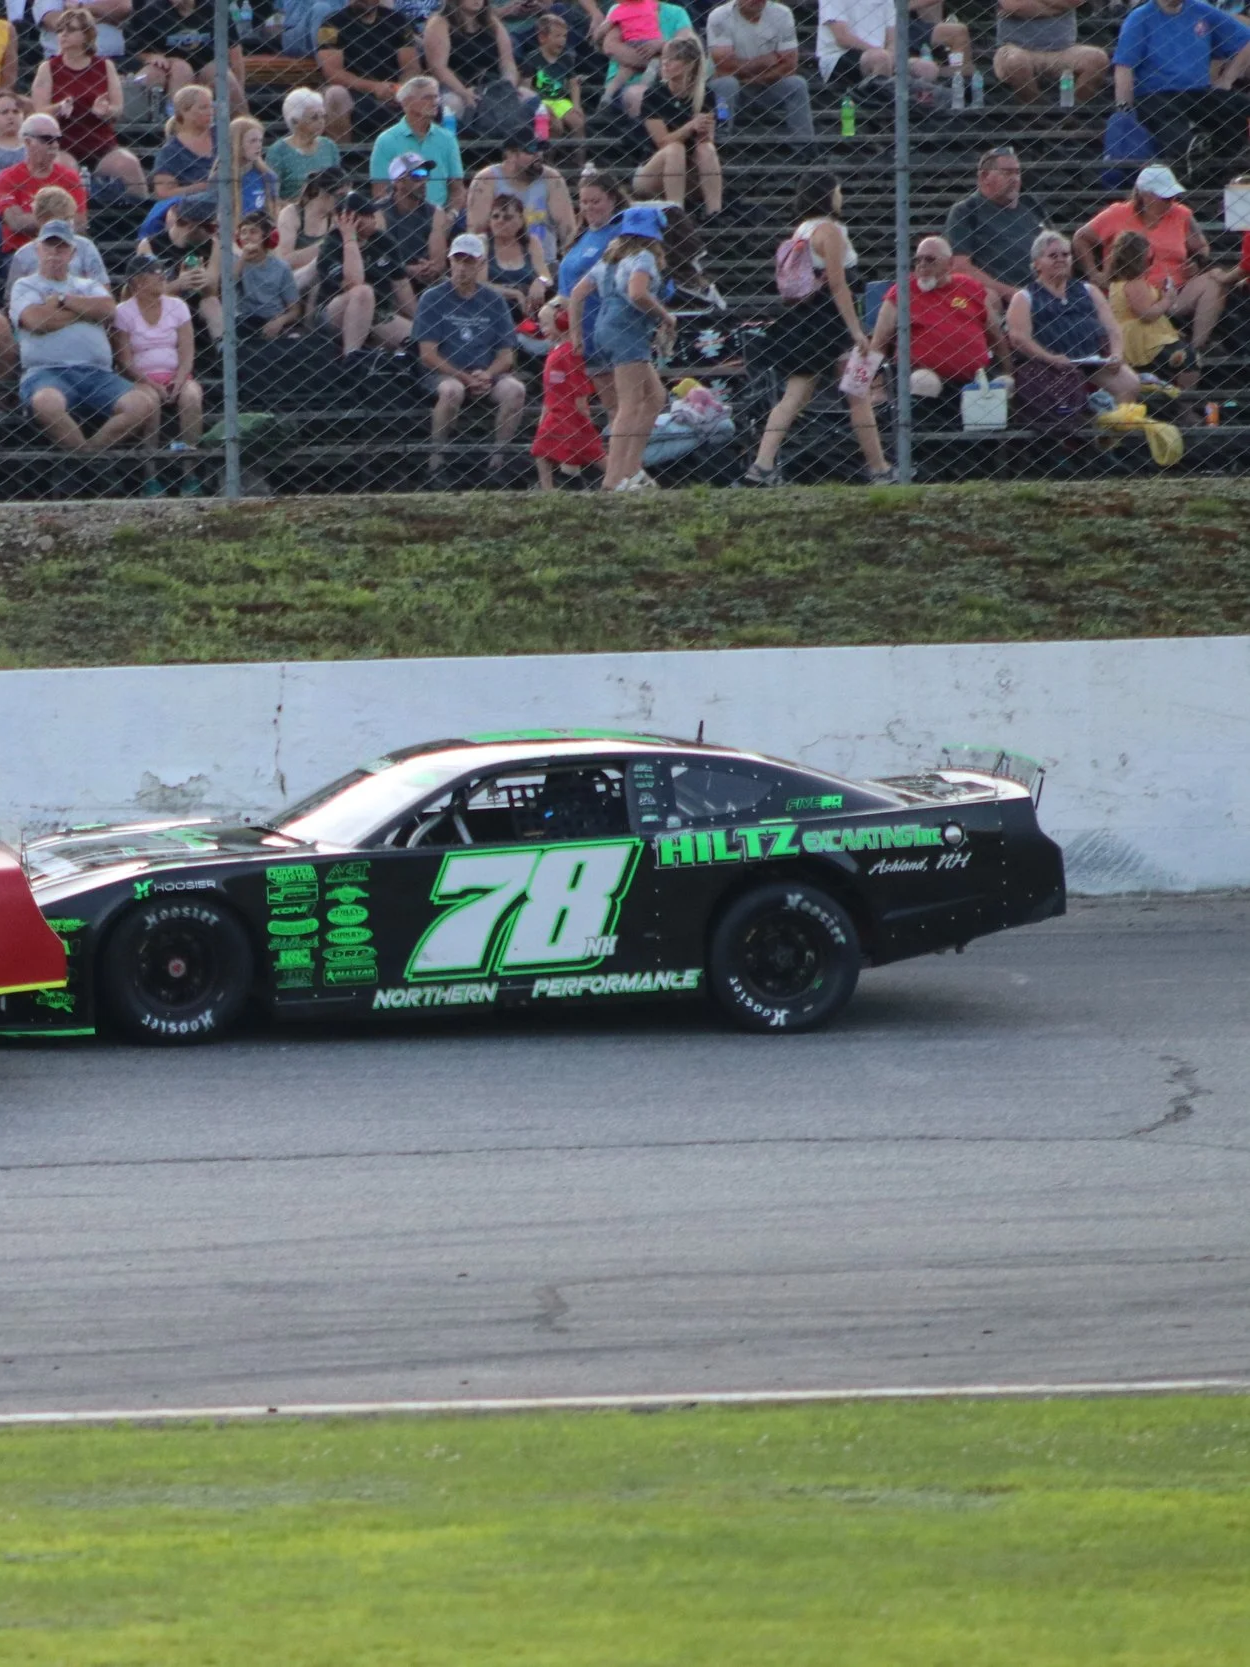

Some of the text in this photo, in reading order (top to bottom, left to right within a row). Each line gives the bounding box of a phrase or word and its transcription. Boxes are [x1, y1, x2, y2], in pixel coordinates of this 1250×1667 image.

[655, 825, 800, 869] HILTZ
[802, 825, 914, 853] EXCAVATING
[868, 857, 928, 875] Ashland,
[154, 879, 217, 893] HOOSIER
[404, 836, 645, 983] 78
[584, 935, 619, 957] NH
[372, 968, 703, 1010] NORTHERN PERFORMANCE
